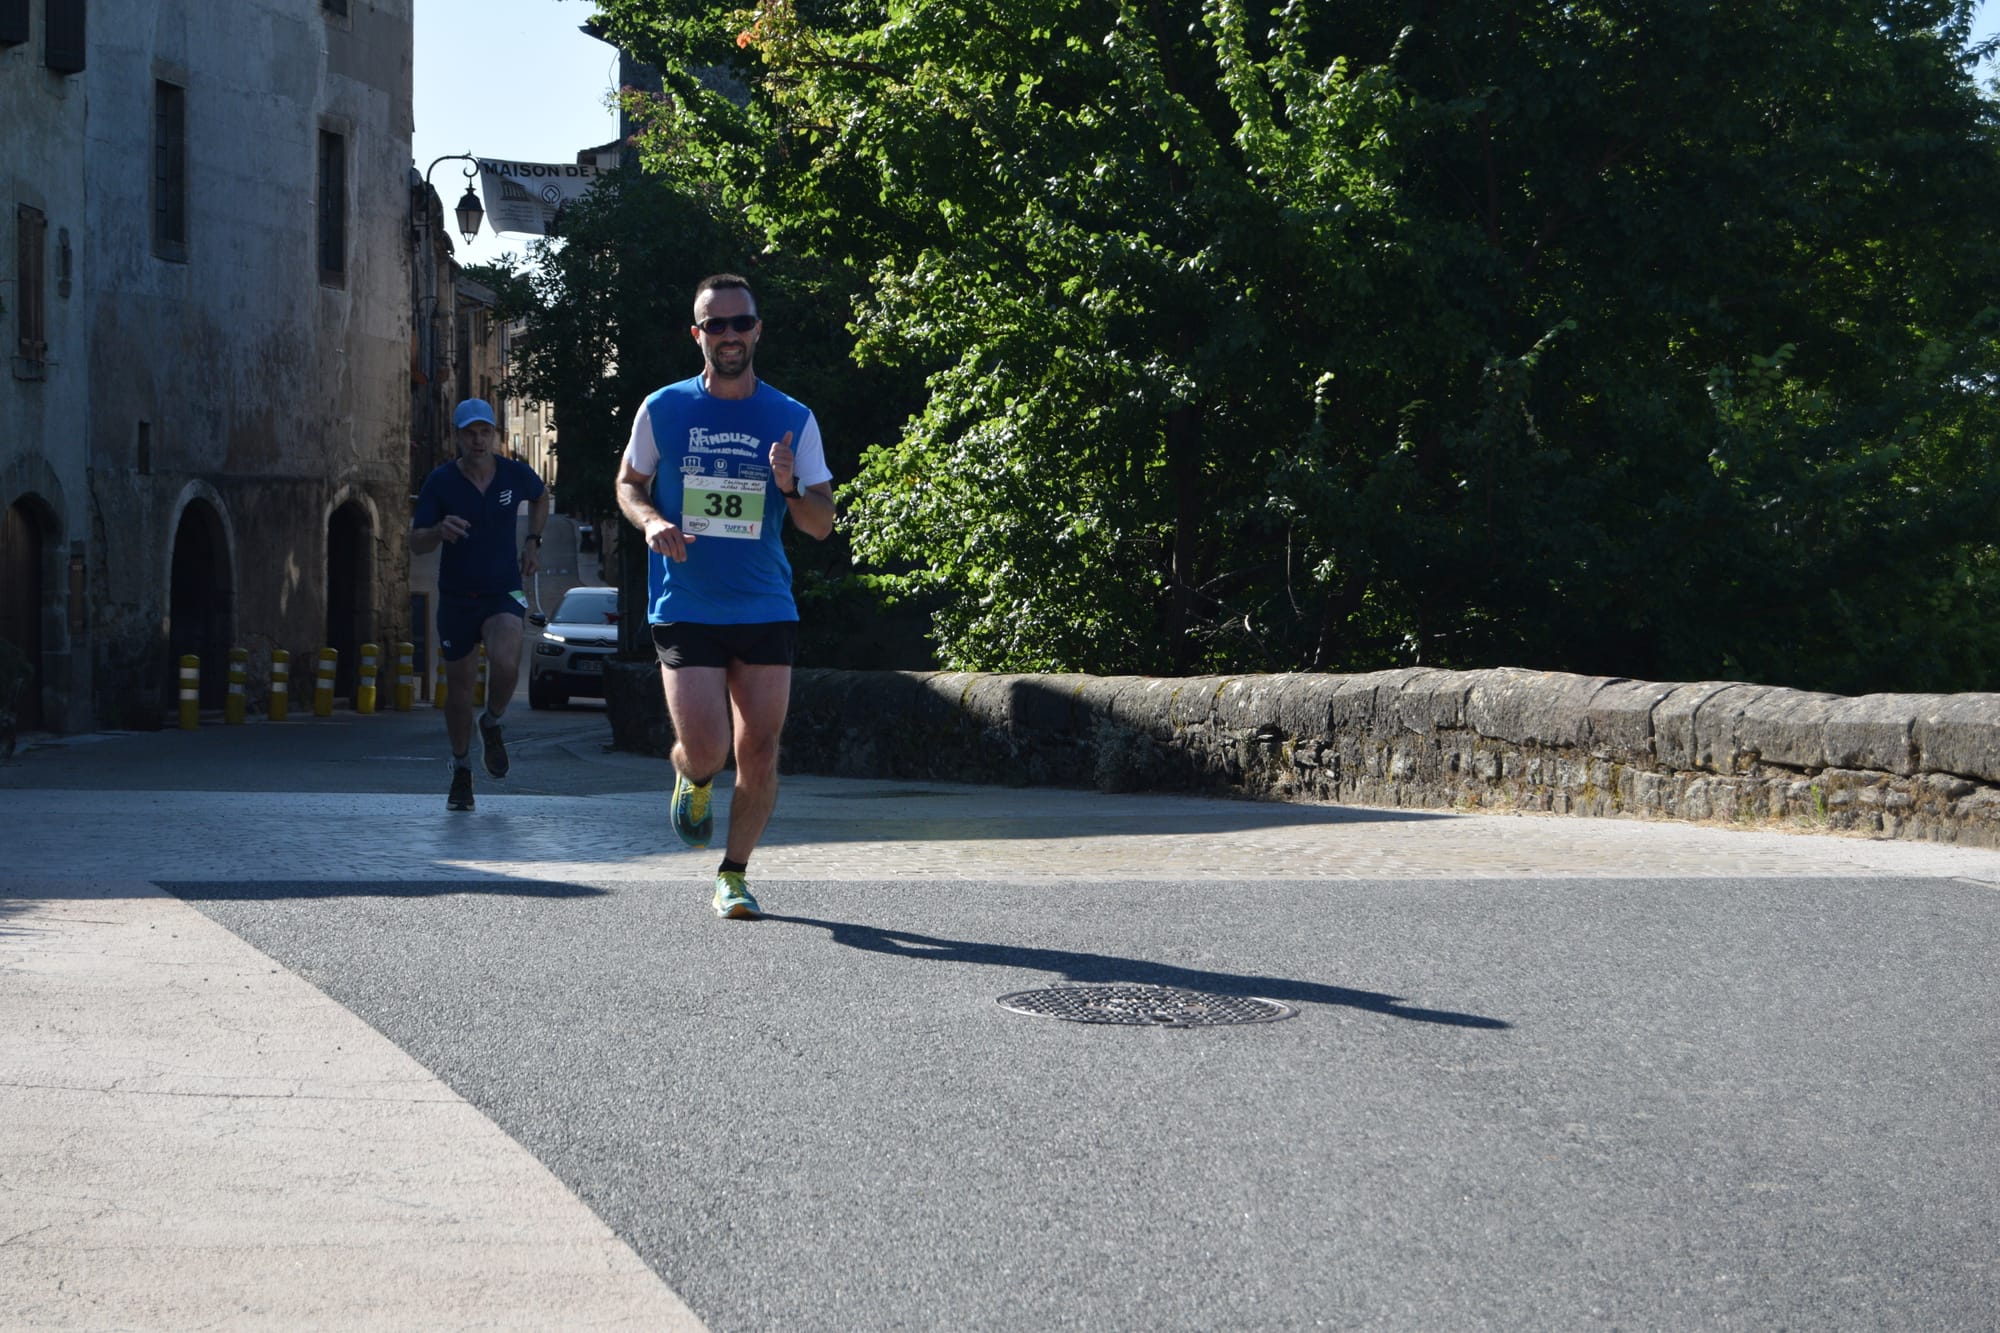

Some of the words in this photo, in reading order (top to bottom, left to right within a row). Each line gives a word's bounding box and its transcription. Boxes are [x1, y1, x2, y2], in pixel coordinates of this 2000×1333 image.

[483, 163, 559, 177] MAISON
[565, 166, 590, 177] DE
[704, 493, 742, 518] 38
